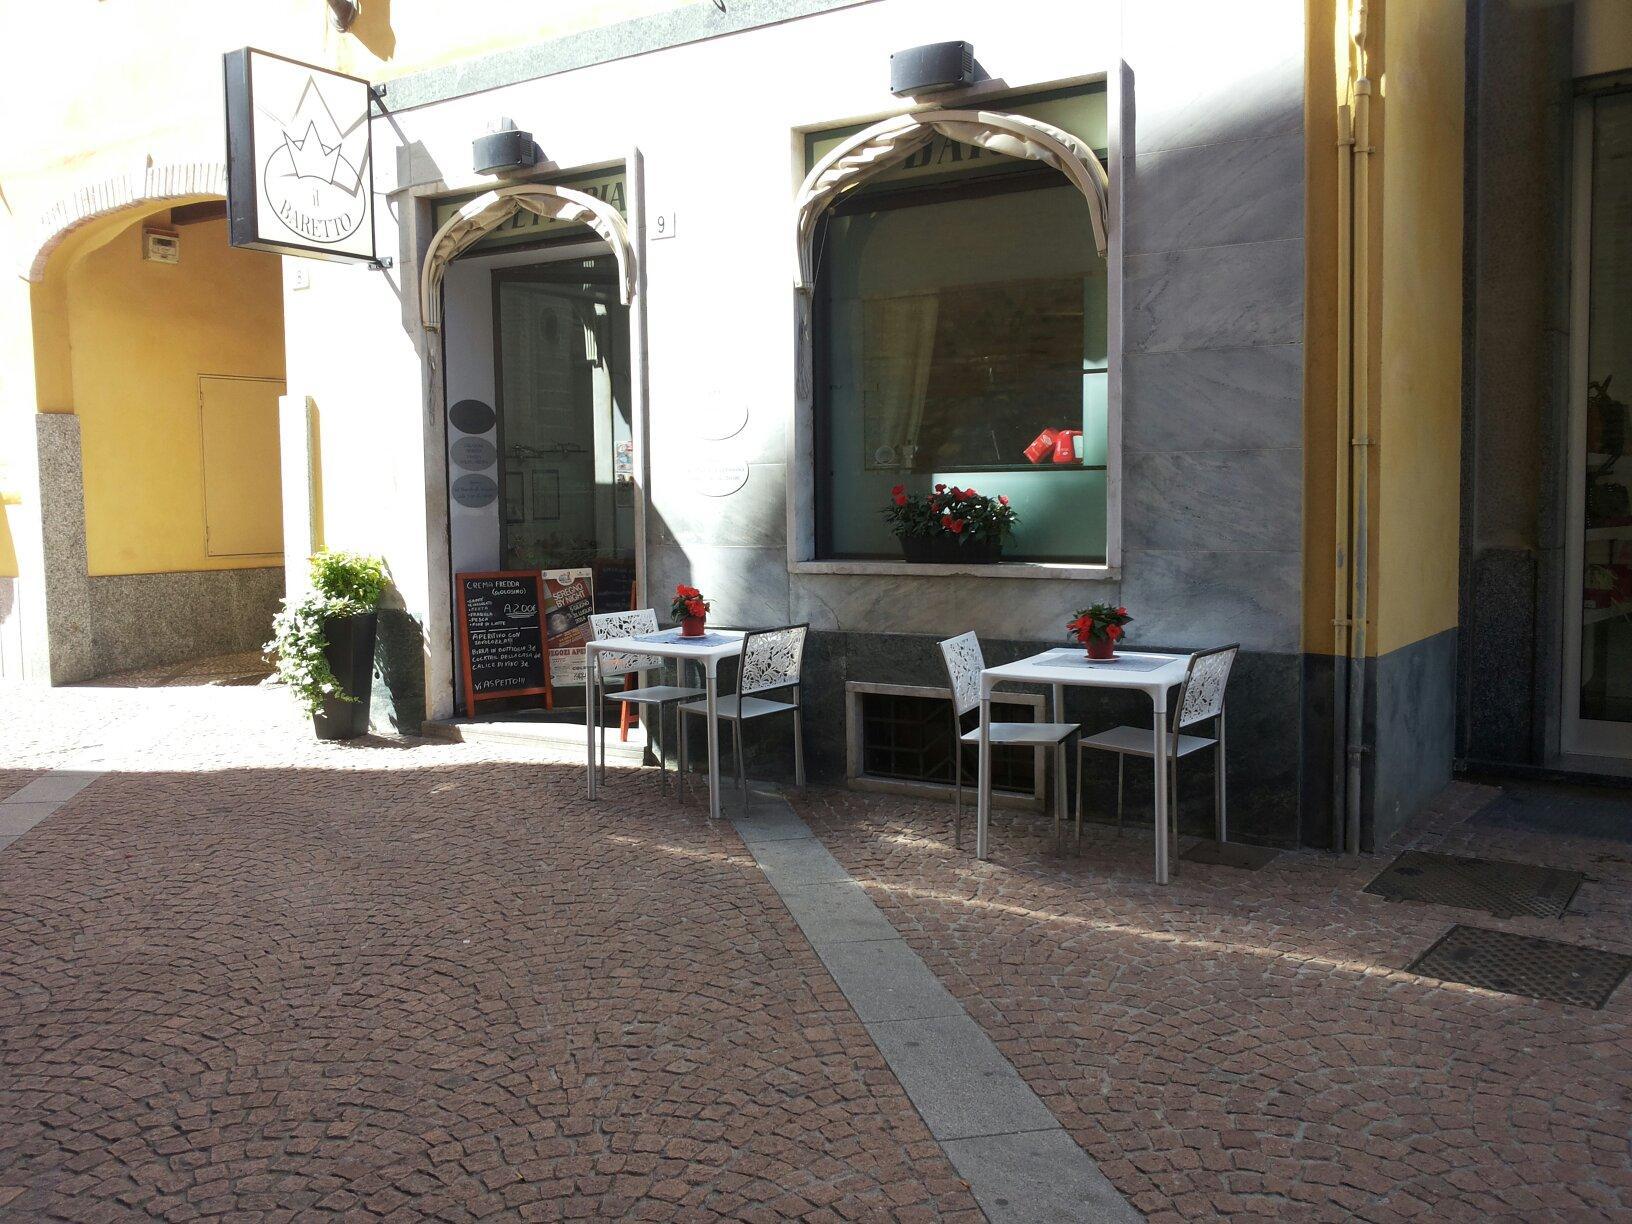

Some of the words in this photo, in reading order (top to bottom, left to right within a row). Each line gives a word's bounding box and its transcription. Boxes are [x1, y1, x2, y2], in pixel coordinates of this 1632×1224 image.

[280, 199, 352, 238] BARETTO
[657, 215, 666, 233] 9
[467, 581, 493, 590] CREMA
[495, 580, 520, 588] FREDDA
[552, 582, 584, 601] SEREGNO
[472, 632, 506, 640] APERITIVO
